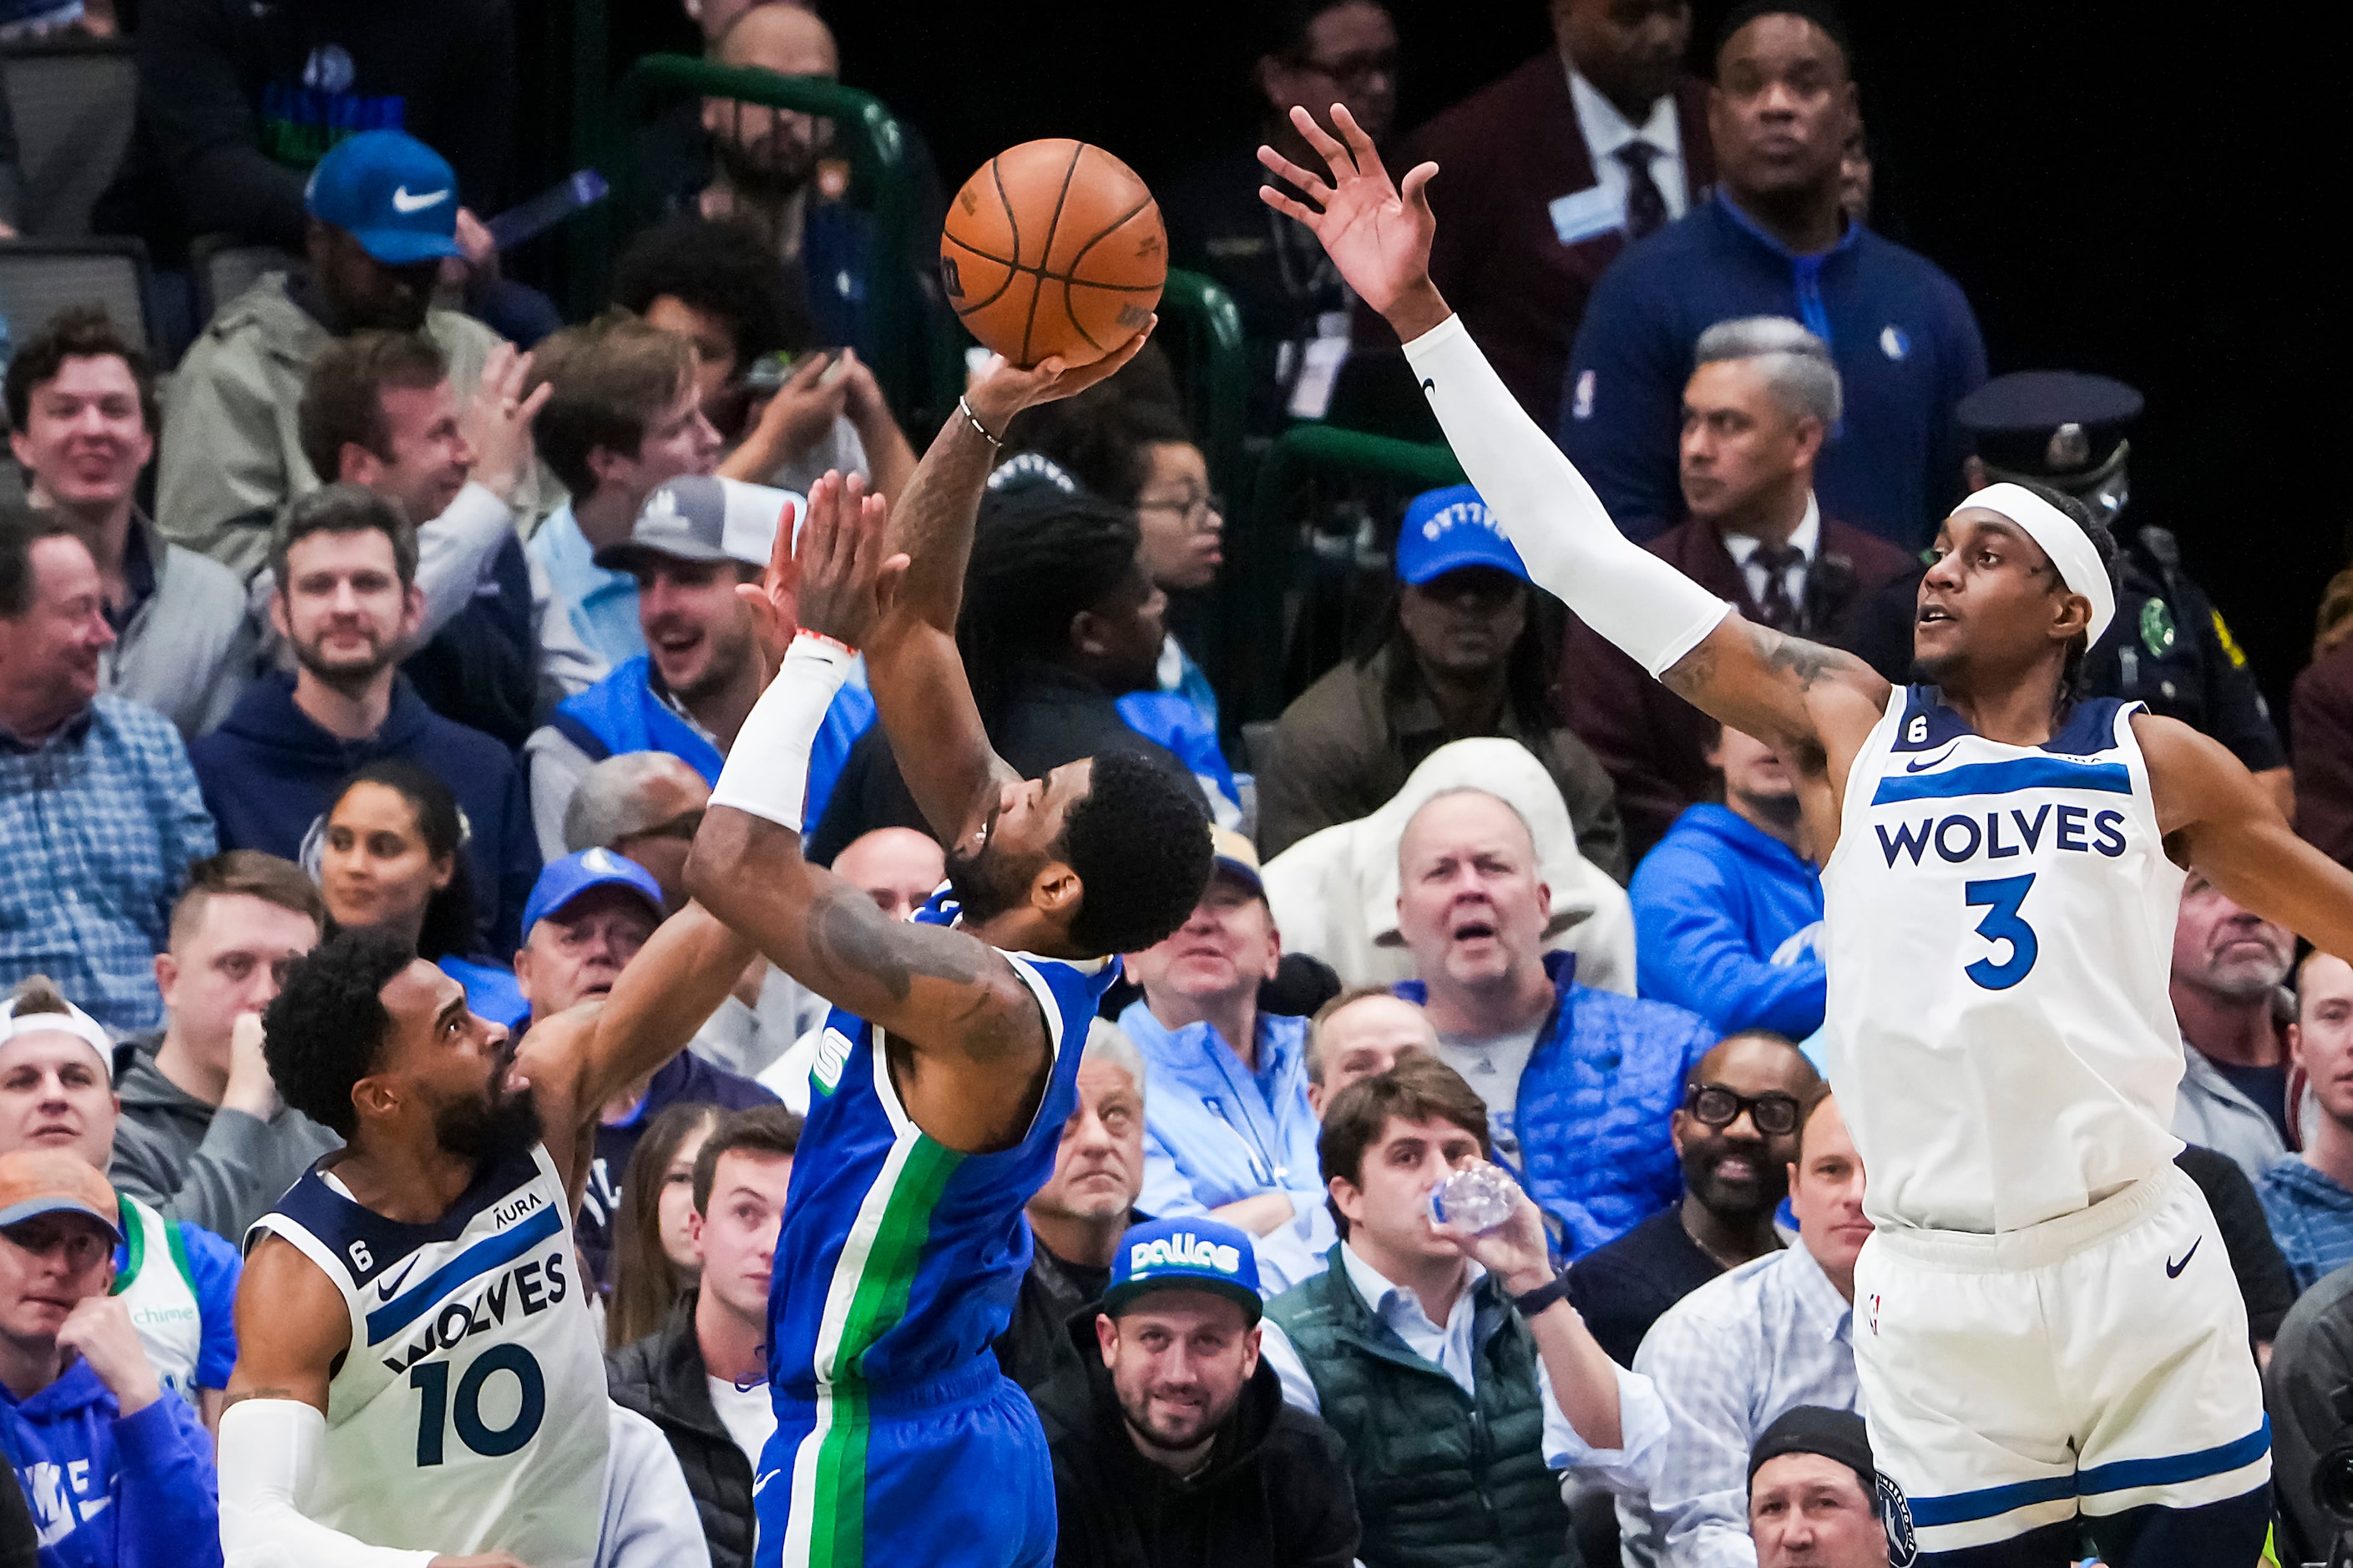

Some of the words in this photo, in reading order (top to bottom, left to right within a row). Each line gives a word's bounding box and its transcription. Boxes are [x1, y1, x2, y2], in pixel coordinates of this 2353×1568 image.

[1907, 716, 1928, 743] 6
[1875, 803, 2127, 869] WOLVES
[1964, 872, 2038, 991] 3
[348, 1240, 374, 1272] 6
[134, 1305, 195, 1325] chime
[382, 1252, 567, 1375] WOLVES
[410, 1343, 546, 1468] 10
